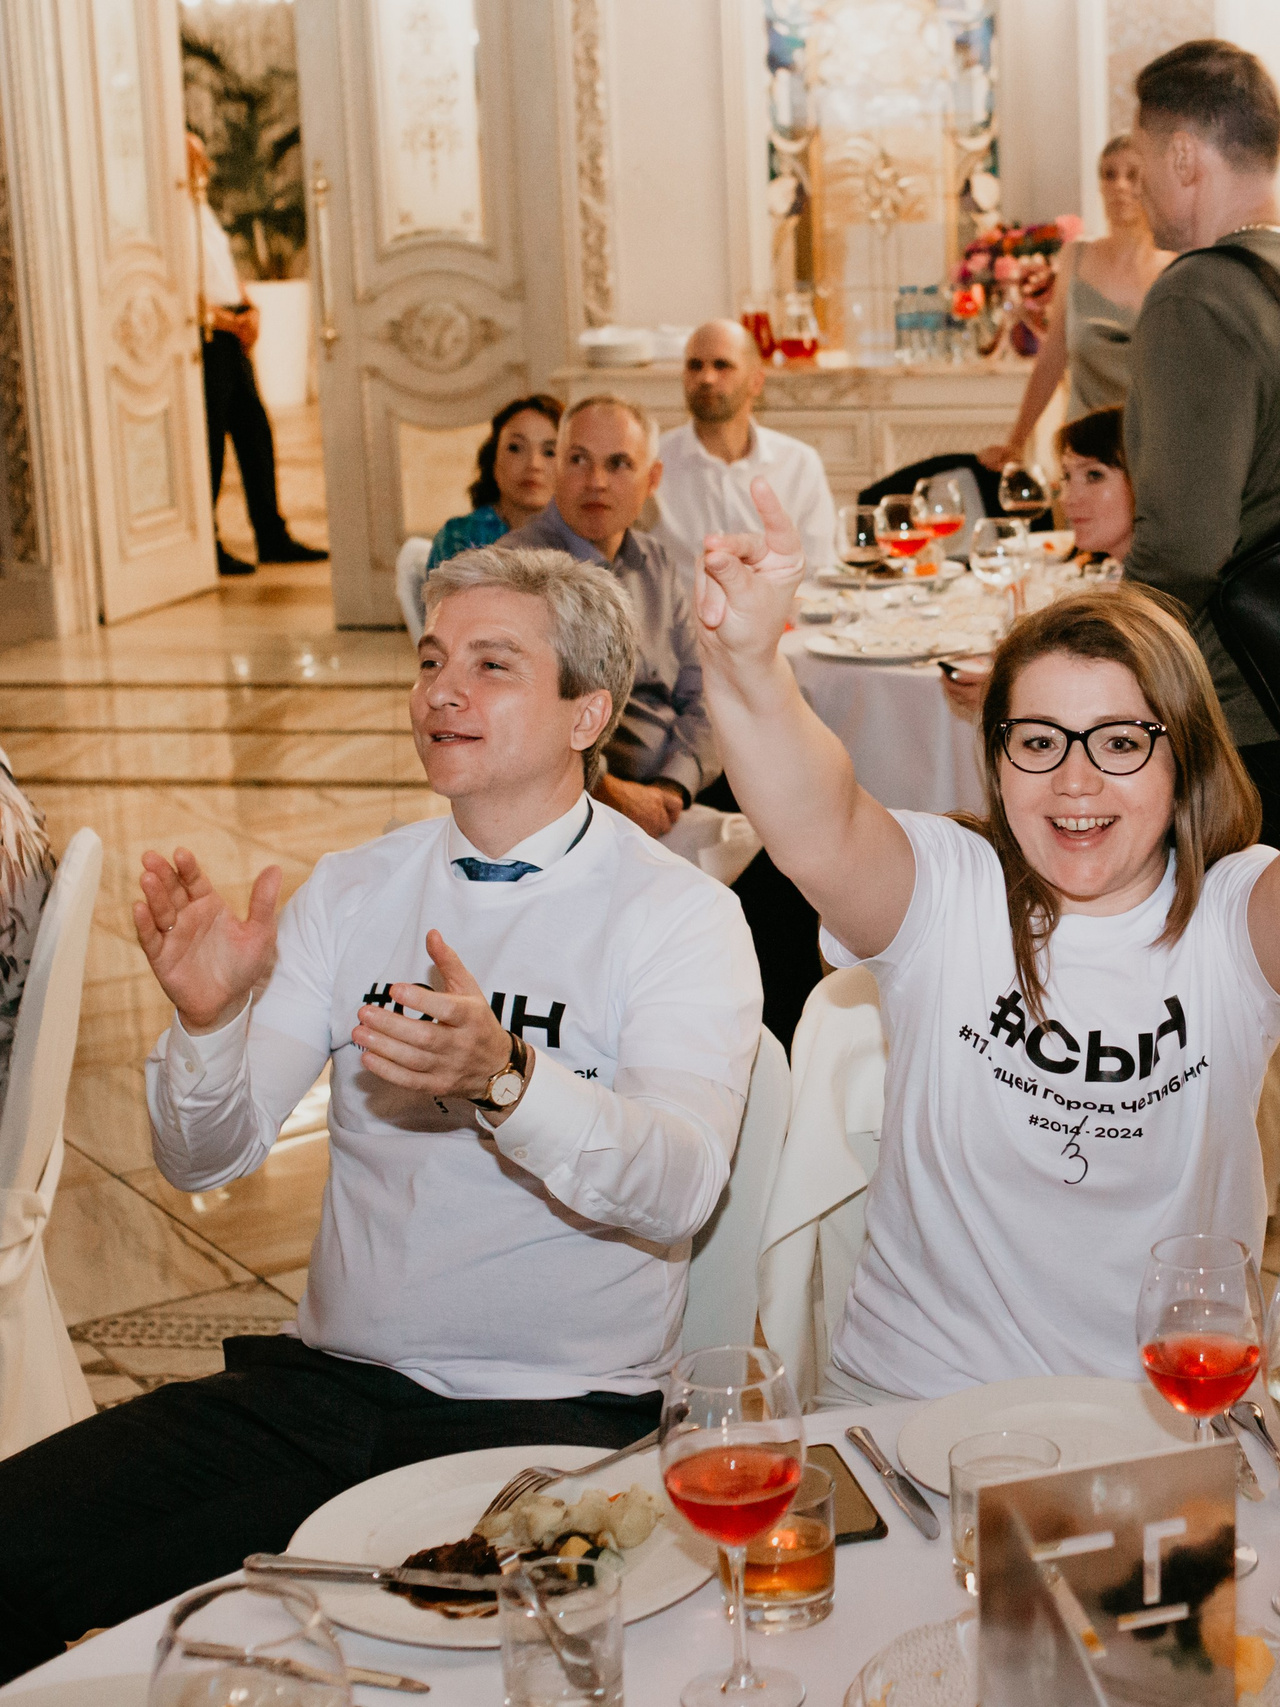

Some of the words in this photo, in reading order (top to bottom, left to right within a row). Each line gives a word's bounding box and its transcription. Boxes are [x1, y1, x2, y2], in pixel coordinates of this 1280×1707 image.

[989, 990, 1187, 1083] #СЫН
[1042, 1087, 1115, 1114] город
[1095, 1127, 1143, 1139] 2024
